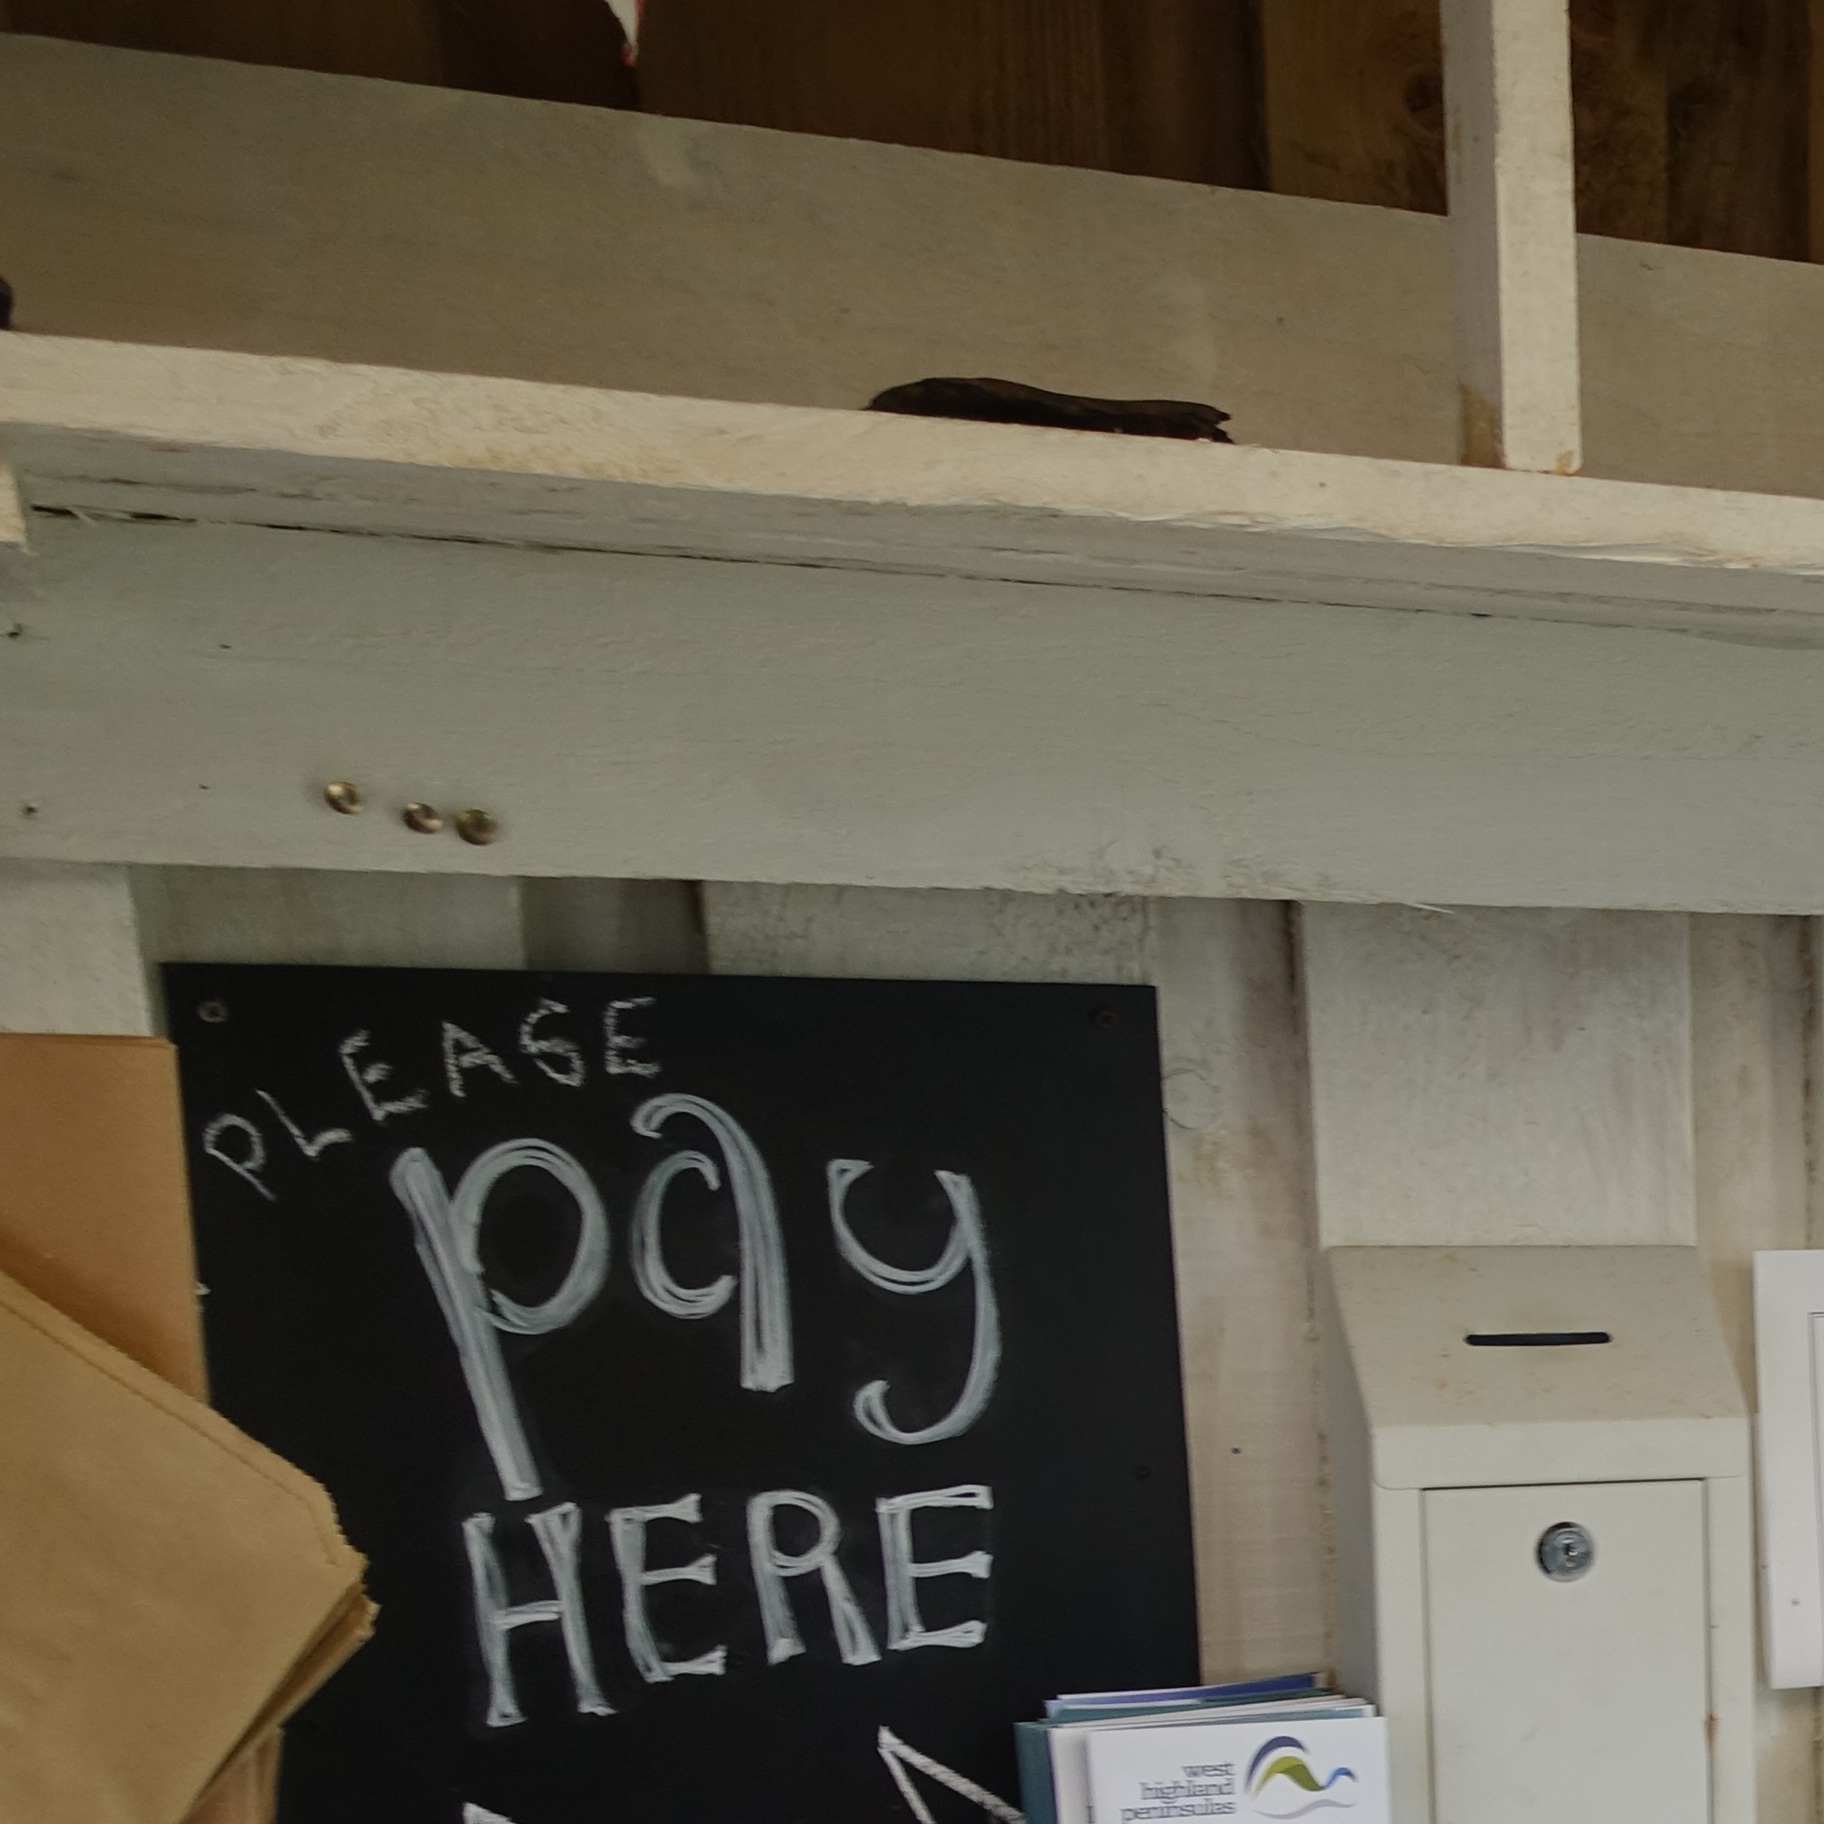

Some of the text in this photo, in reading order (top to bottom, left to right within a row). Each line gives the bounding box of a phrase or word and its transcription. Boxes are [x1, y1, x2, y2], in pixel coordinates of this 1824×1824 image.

[202, 998, 664, 1200] PLEASE
[390, 1092, 1002, 1501] pay
[463, 1484, 995, 1728] HERE
[1140, 1779, 1235, 1804] highland
[1182, 1761, 1234, 1779] west
